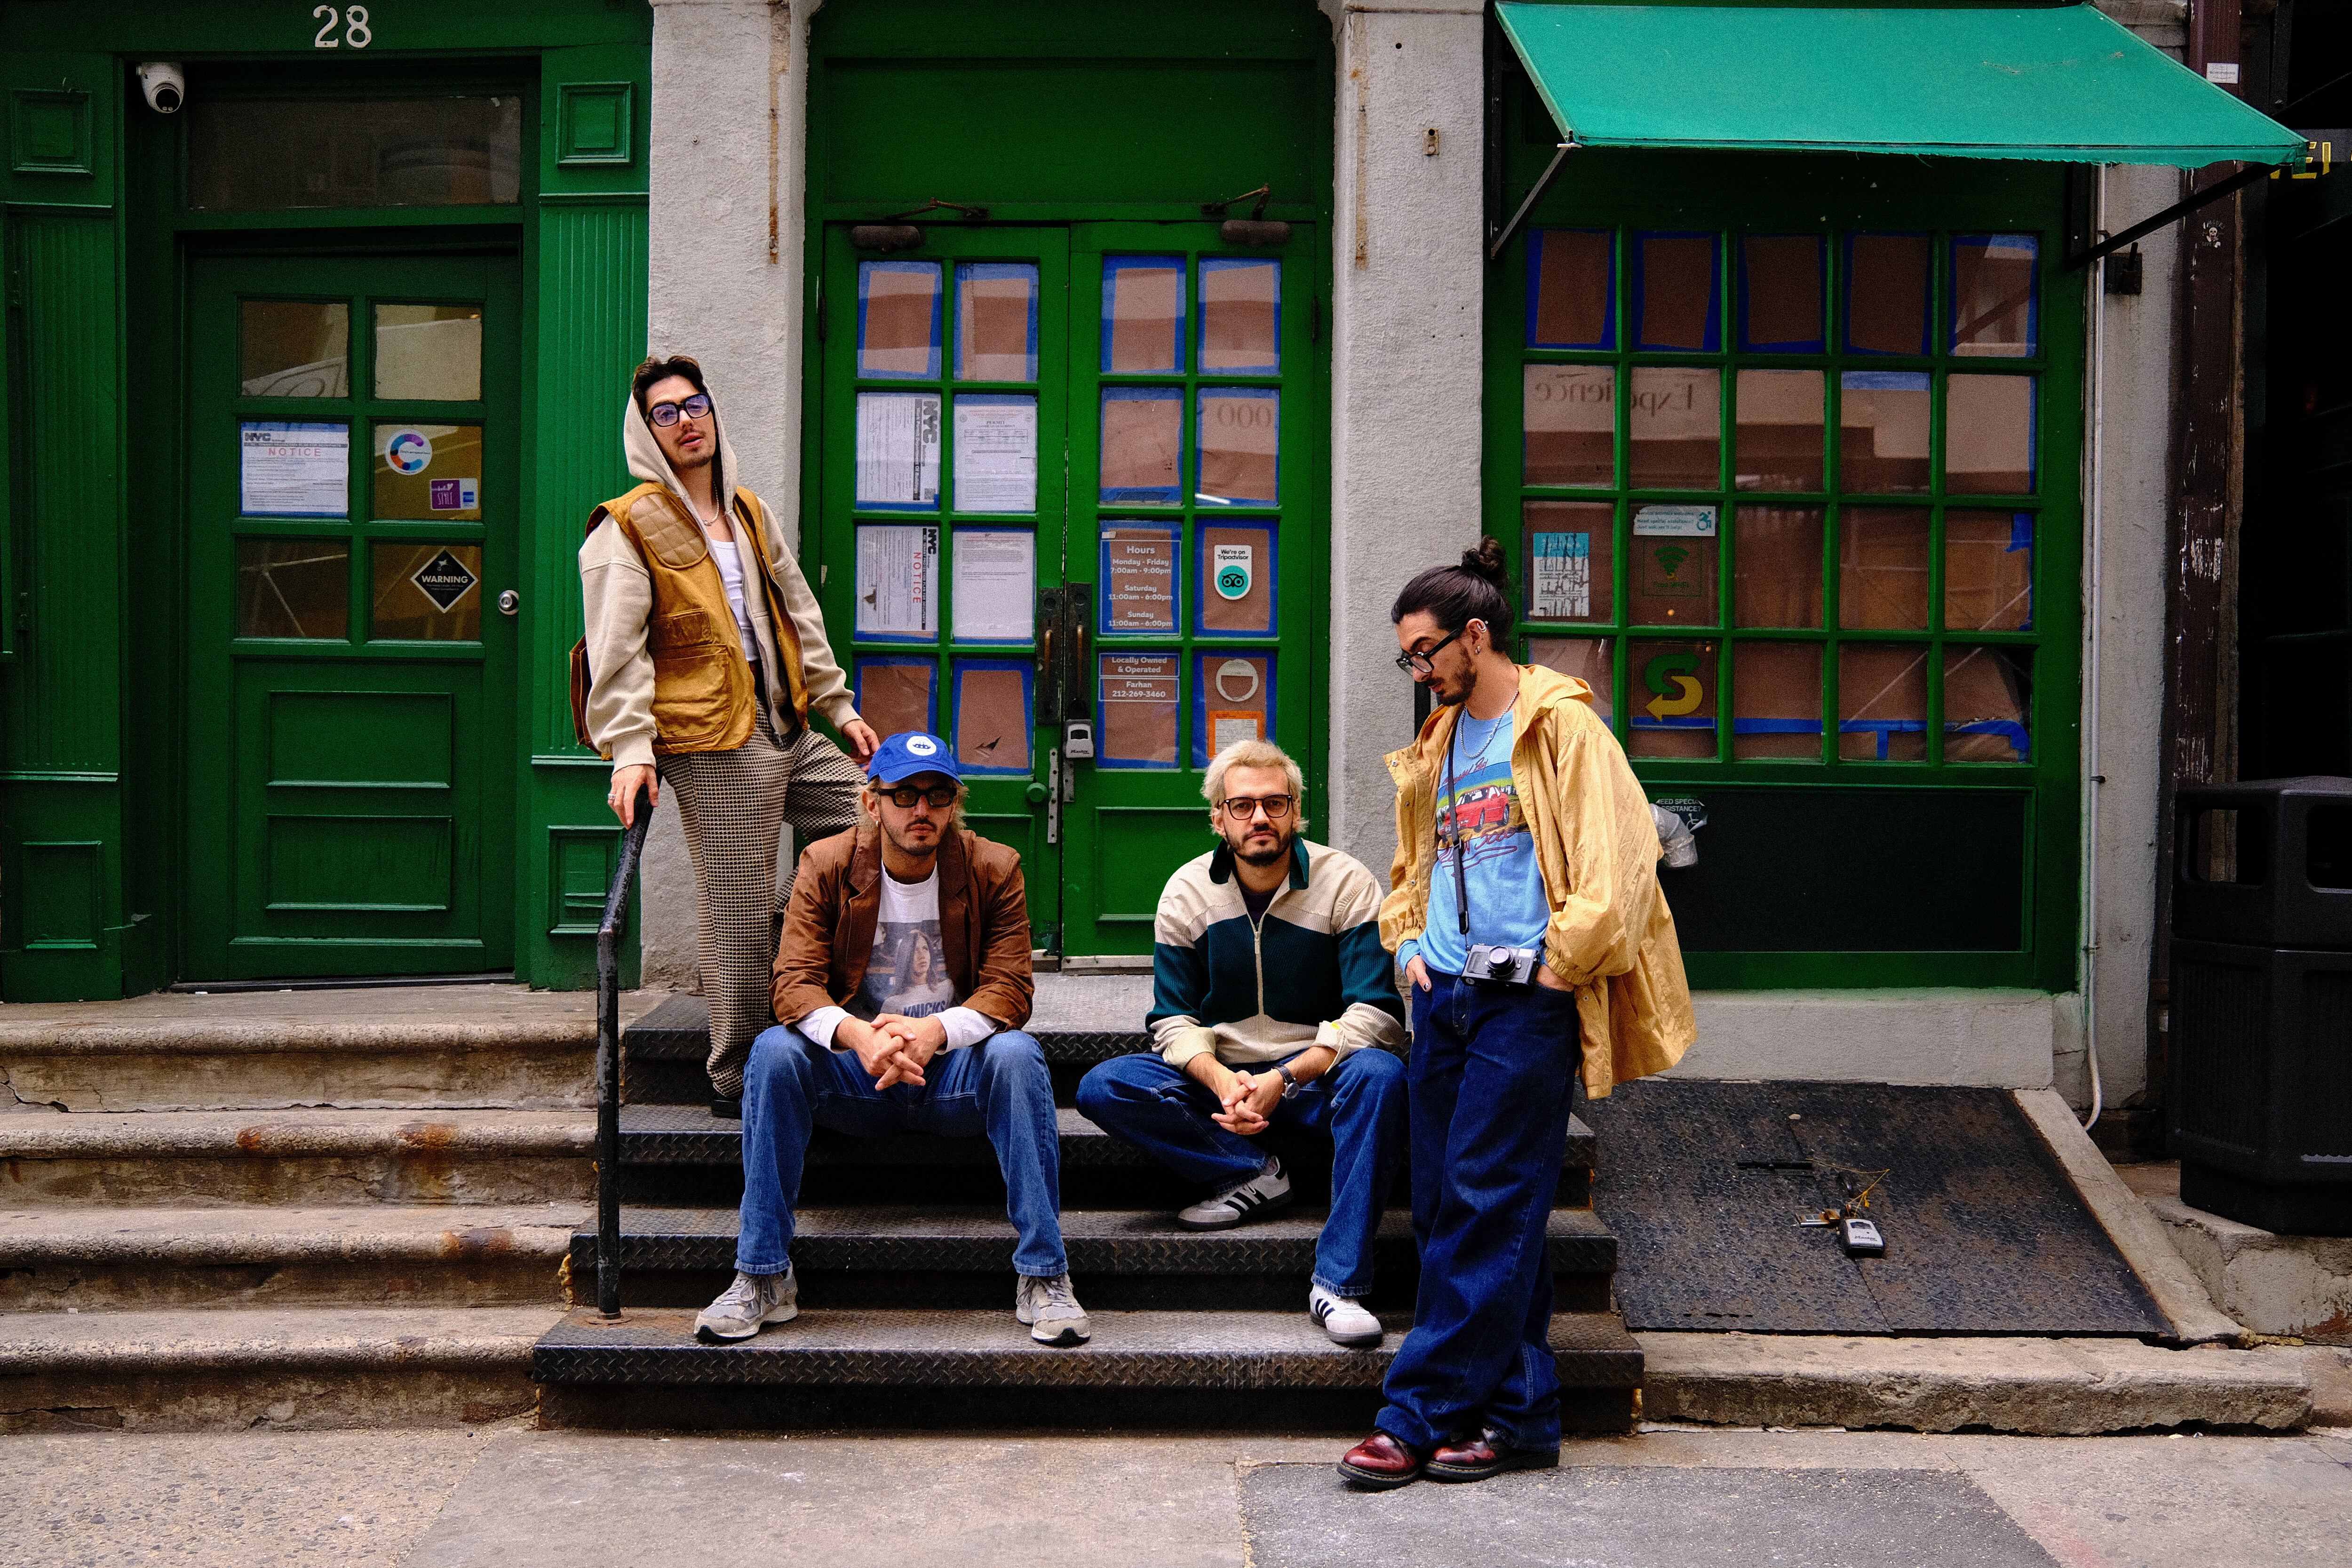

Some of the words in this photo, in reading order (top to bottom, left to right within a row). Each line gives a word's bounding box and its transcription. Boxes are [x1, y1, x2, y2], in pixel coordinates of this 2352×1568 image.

[313, 5, 372, 48] 28
[923, 401, 938, 444] NYC
[245, 433, 271, 441] NYC
[269, 448, 321, 456] NOTICE
[928, 529, 937, 555] NYC
[1127, 546, 1155, 554] Hours
[913, 552, 922, 604] NOTICE
[904, 1001, 946, 1018] KNICKS
